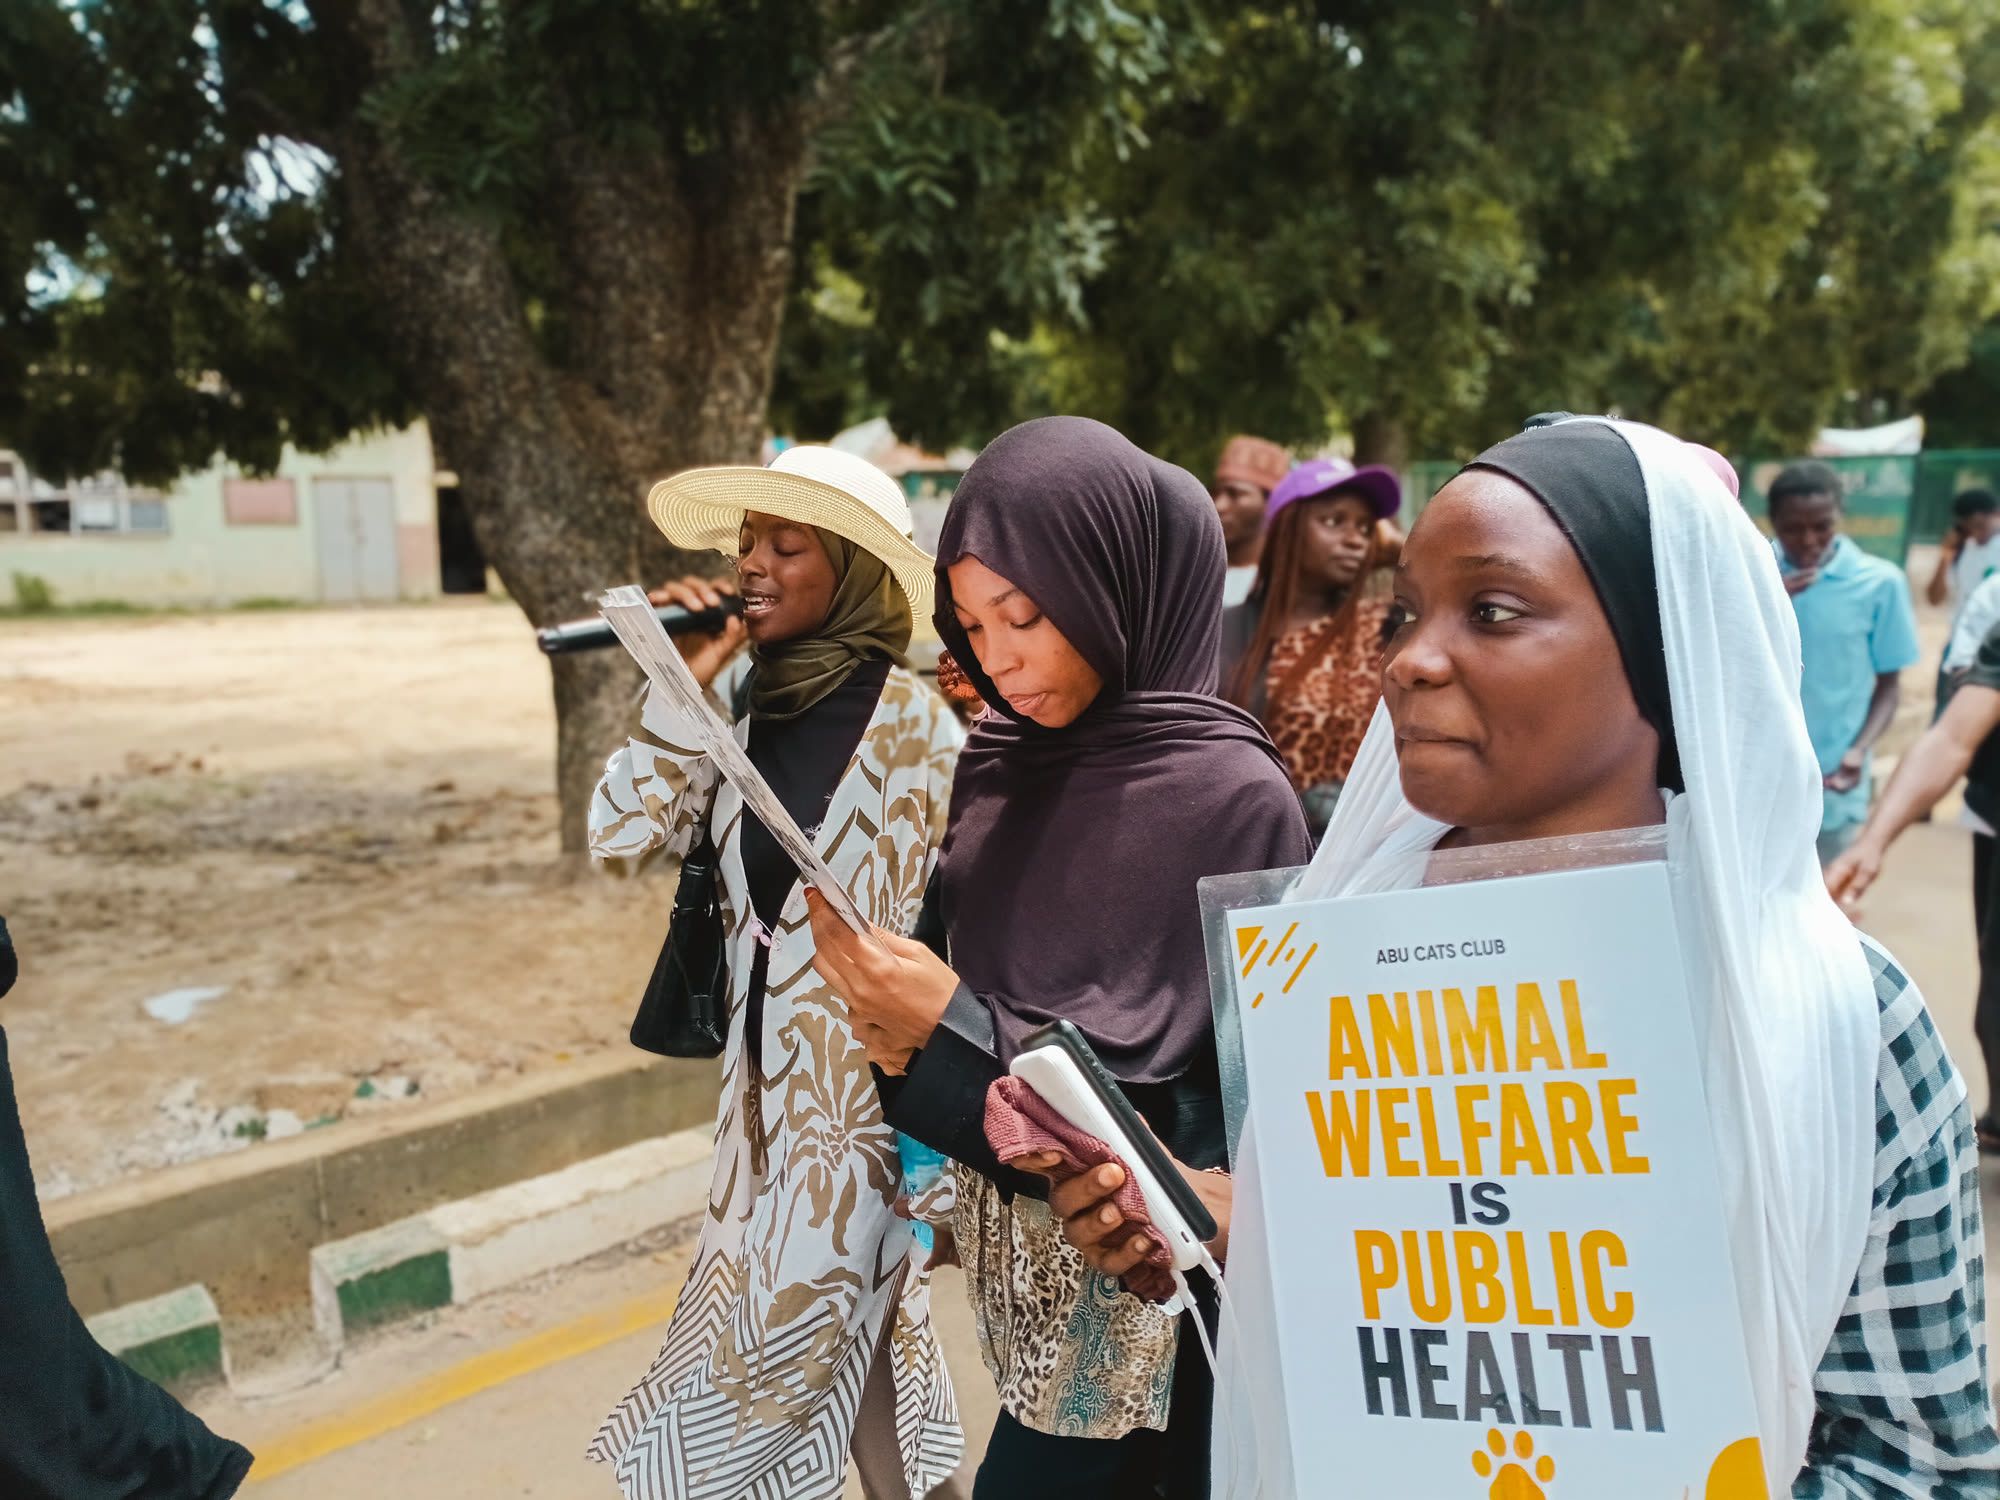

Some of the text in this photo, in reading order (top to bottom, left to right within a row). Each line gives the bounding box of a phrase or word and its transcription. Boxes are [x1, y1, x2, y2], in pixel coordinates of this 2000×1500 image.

[1376, 939, 1506, 965] ABU CATS CLUB
[1328, 979, 1608, 1081] ANIMAL
[1304, 1078, 1651, 1178] WELFARE
[1448, 1182, 1512, 1227] IS
[1353, 1229, 1635, 1329] PUBLIC
[1356, 1326, 1667, 1433] HEALTH
